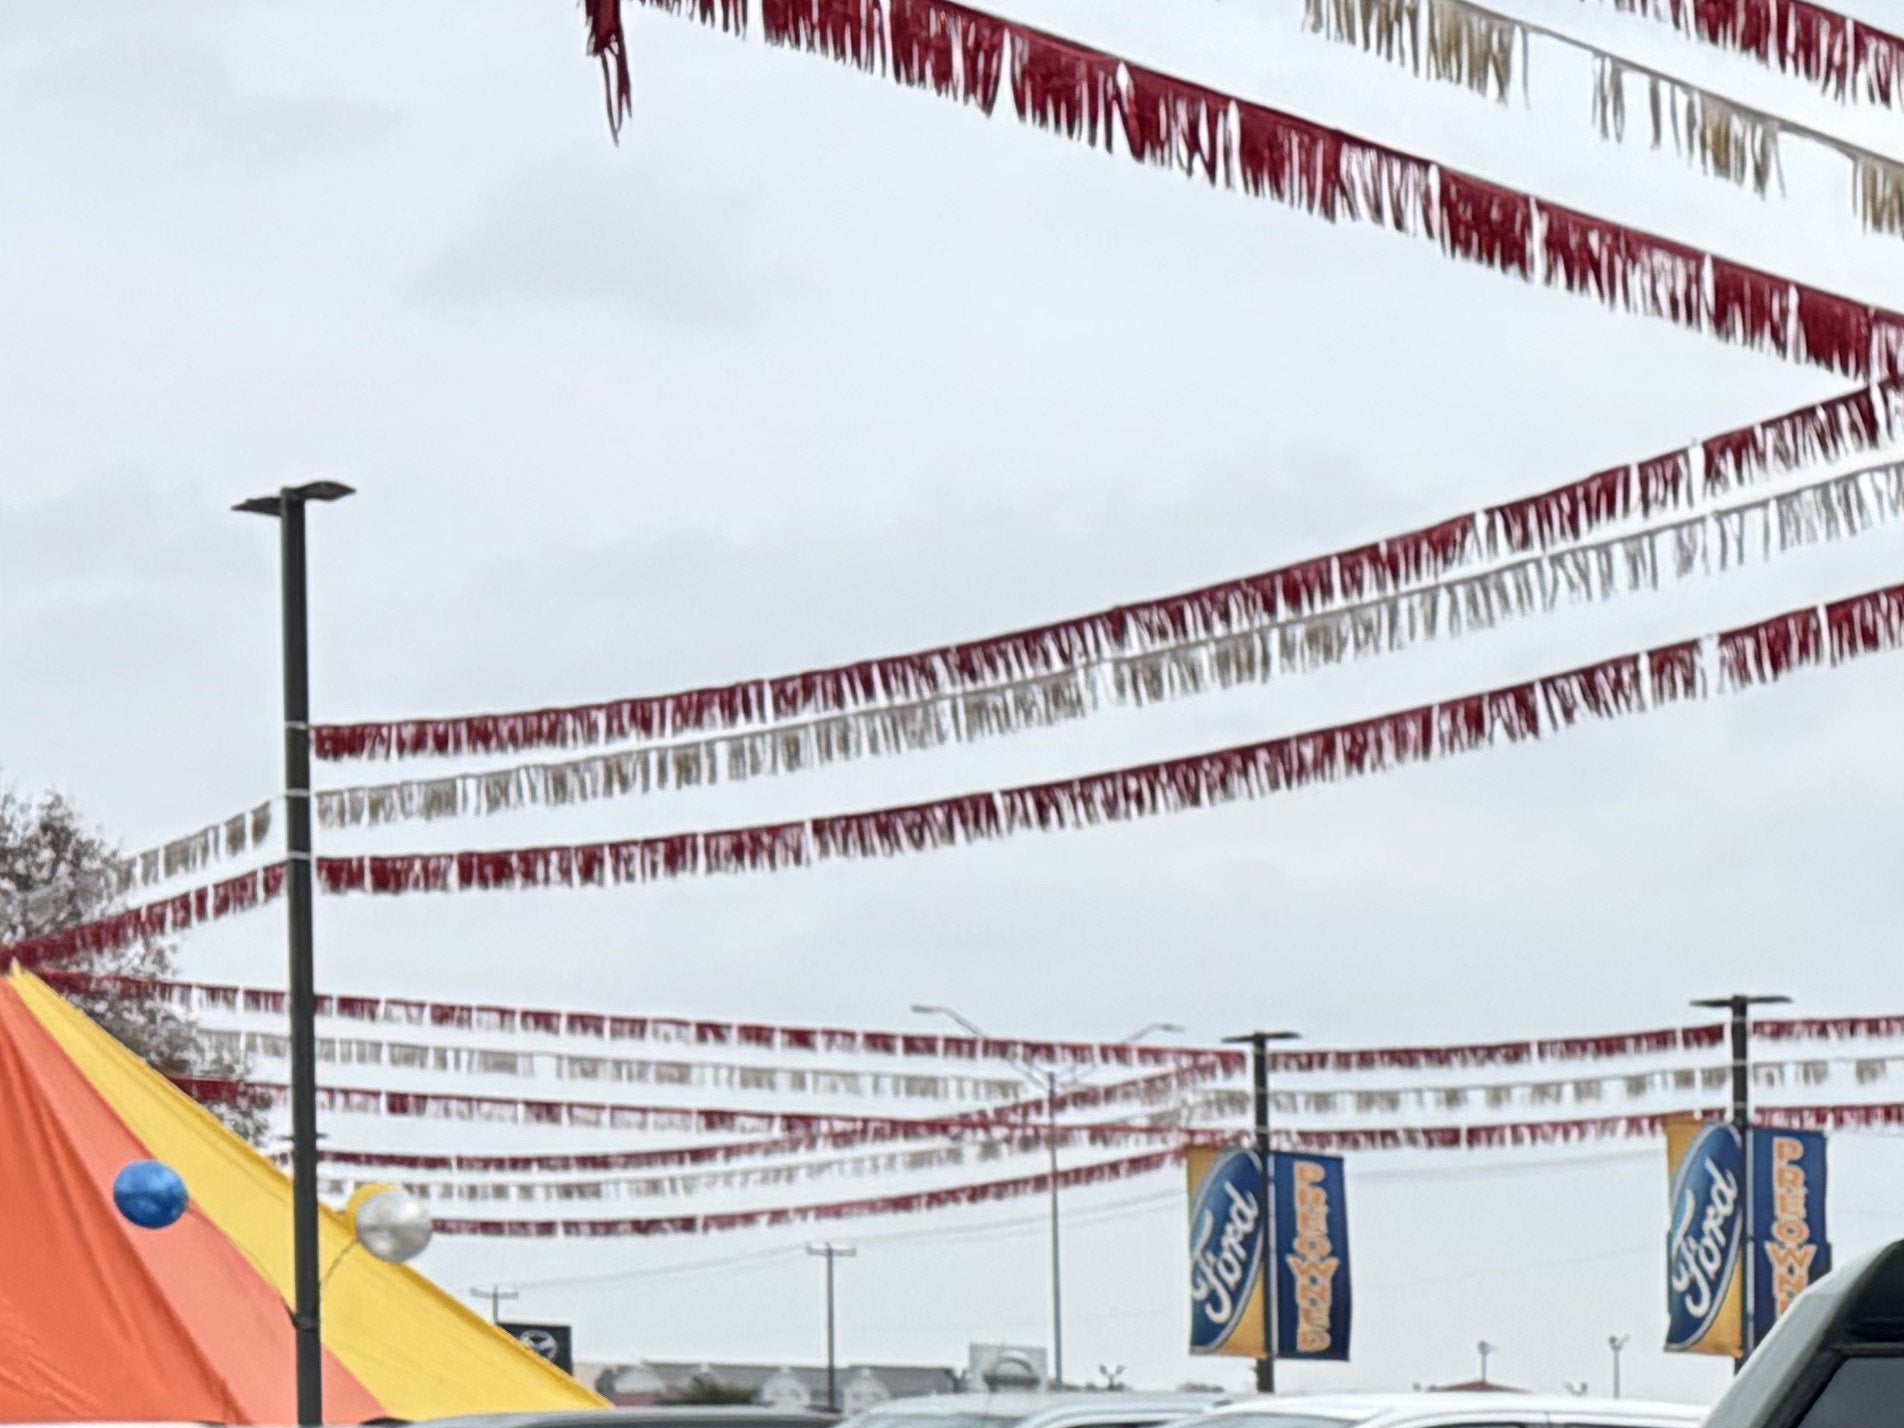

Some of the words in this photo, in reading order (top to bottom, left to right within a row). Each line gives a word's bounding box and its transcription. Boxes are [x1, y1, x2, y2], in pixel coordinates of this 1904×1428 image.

[1191, 1180, 1259, 1325] Ford
[1672, 1157, 1738, 1318] Ford
[1764, 1137, 1818, 1322] PREOWN
